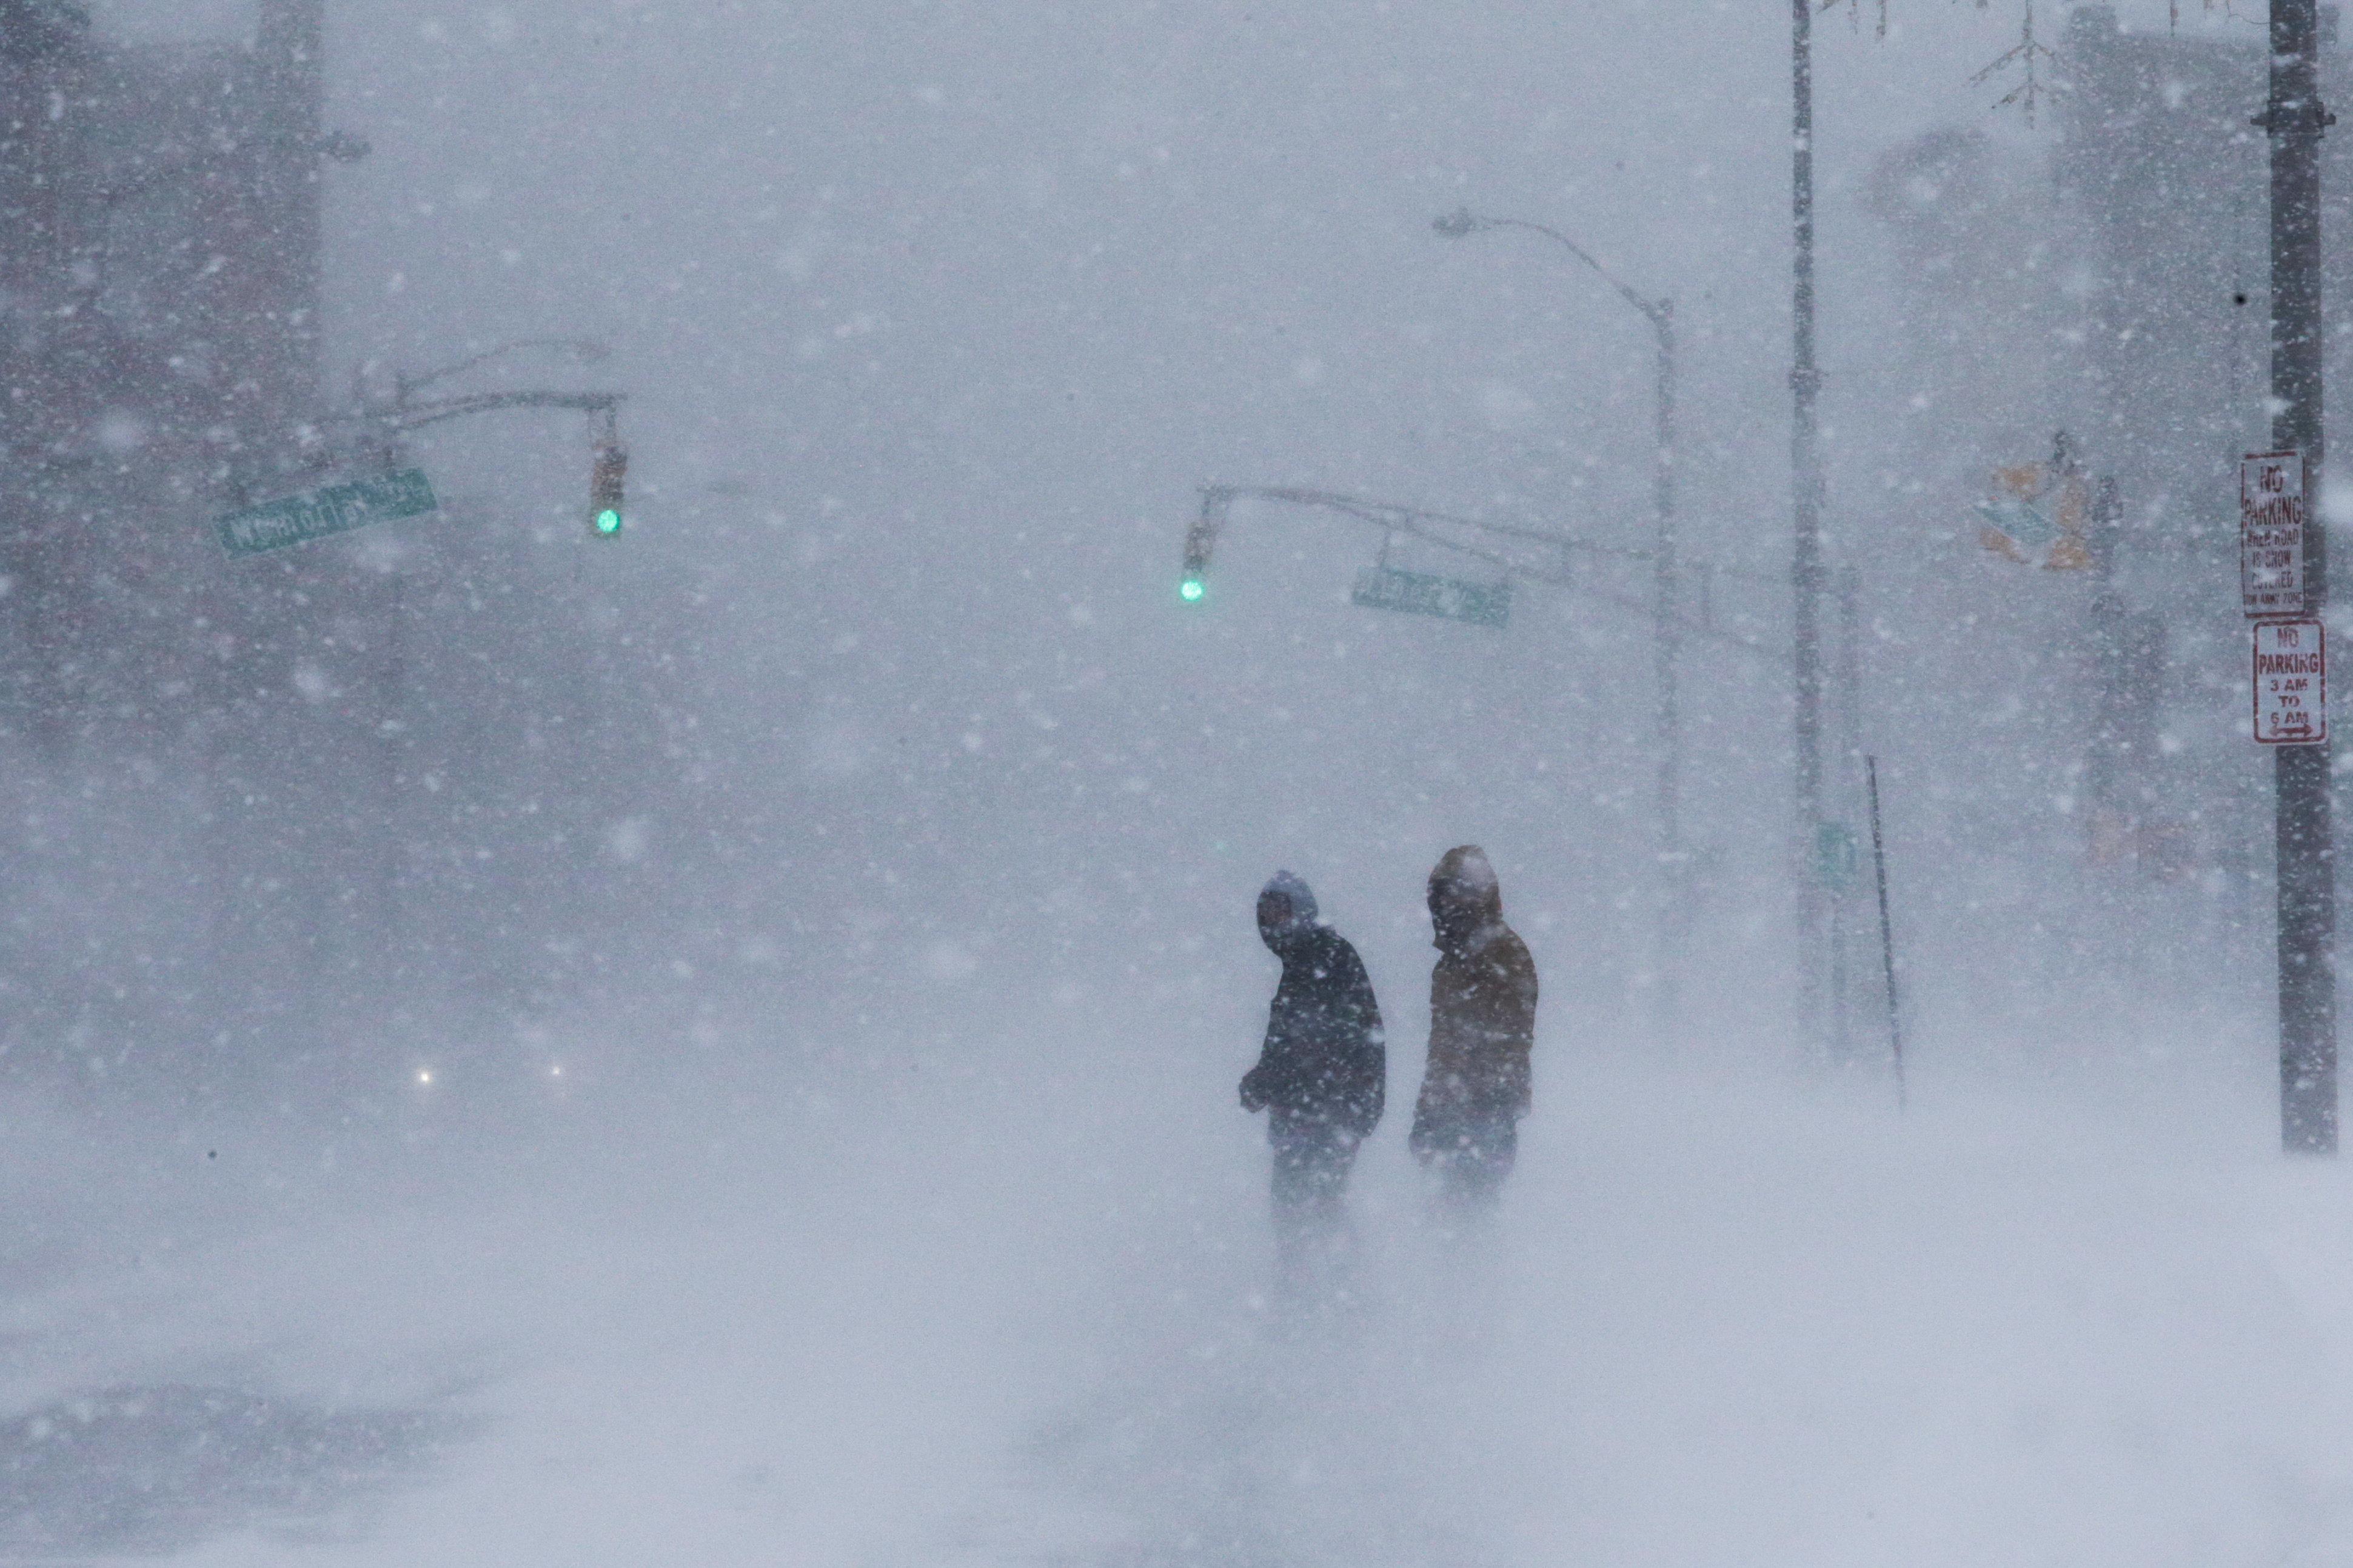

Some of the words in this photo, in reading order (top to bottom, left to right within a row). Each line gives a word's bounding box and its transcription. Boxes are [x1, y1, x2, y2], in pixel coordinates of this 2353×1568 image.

[2260, 465, 2284, 493] NO
[2244, 496, 2302, 526] PARKING
[2246, 530, 2271, 548] WHEN
[2274, 529, 2299, 545] ROAD
[2252, 552, 2261, 568] IS
[2265, 550, 2291, 568] SNOW
[2252, 572, 2294, 590] CORED
[2283, 592, 2303, 604] ZONE
[2277, 627, 2299, 648] NO
[2259, 652, 2319, 675] PARKING
[2270, 679, 2279, 692] 3
[2284, 678, 2308, 691] AM
[2278, 695, 2300, 707] TO
[2284, 711, 2309, 724] AM
